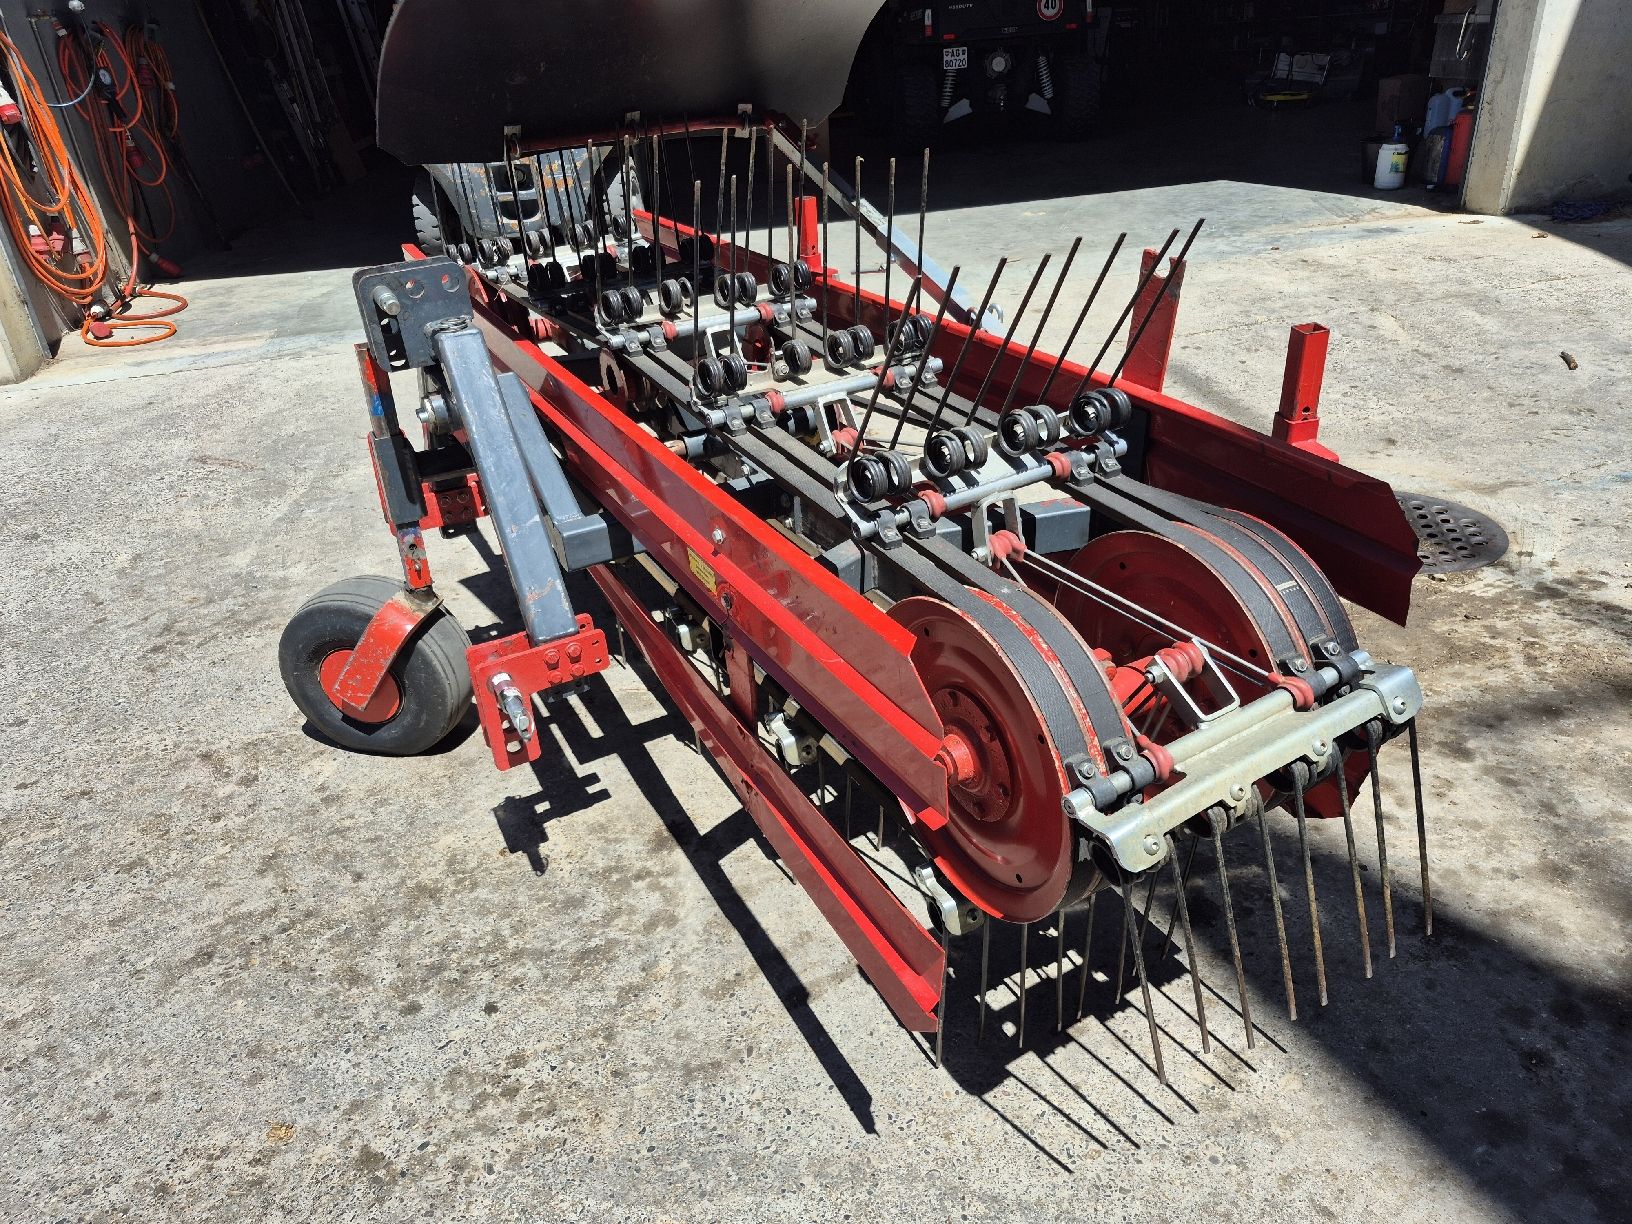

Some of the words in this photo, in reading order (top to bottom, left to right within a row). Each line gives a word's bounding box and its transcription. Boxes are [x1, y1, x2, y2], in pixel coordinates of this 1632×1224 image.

[1044, 0, 1057, 10] 40
[950, 48, 960, 58] AG
[945, 58, 966, 68] 80720
